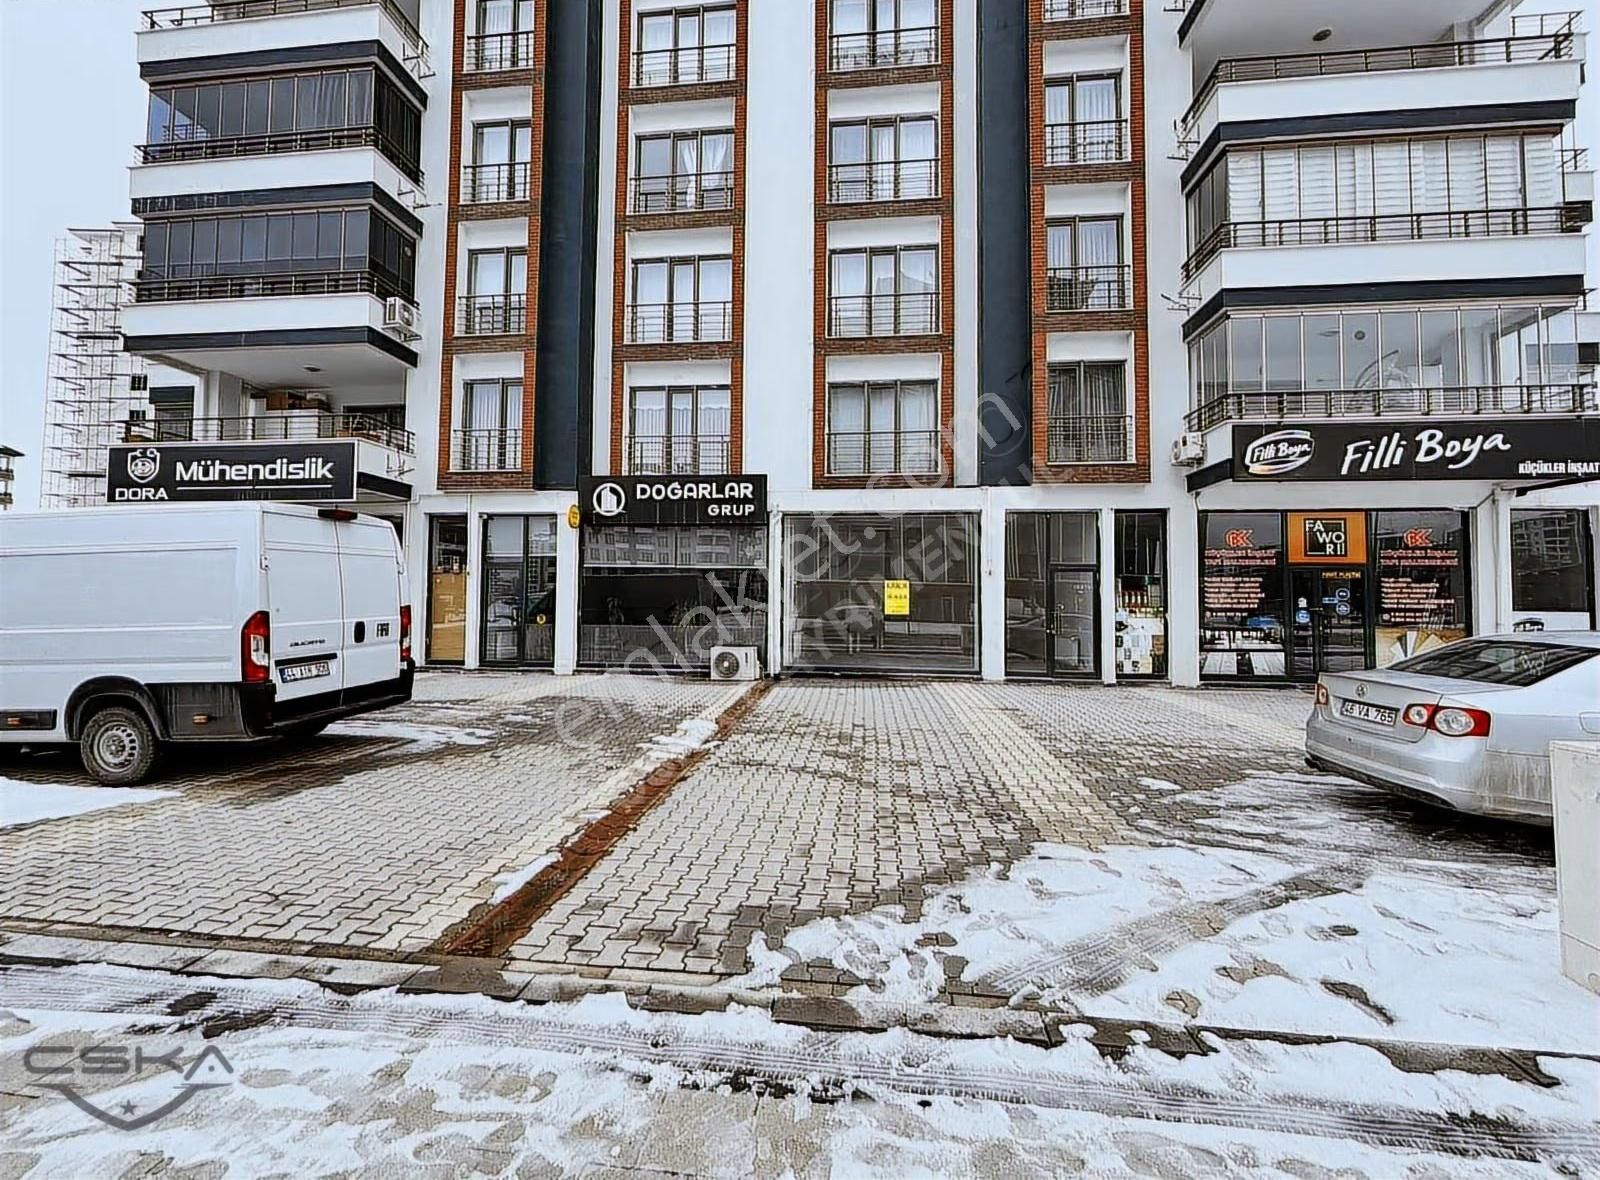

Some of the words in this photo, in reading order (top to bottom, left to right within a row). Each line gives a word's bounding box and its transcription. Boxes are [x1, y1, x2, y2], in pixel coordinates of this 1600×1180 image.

[1253, 446, 1277, 462] Filli
[1278, 440, 1311, 460] Boya
[1341, 433, 1407, 475] Filli
[1416, 430, 1511, 468] Boya
[176, 457, 335, 481] Mühendislik
[1518, 460, 1566, 476] KÜÇÜKLER
[115, 488, 168, 501] DORA
[636, 480, 754, 500] DOĞARLAR
[708, 505, 755, 517] GRUP
[1374, 708, 1394, 723] 765
